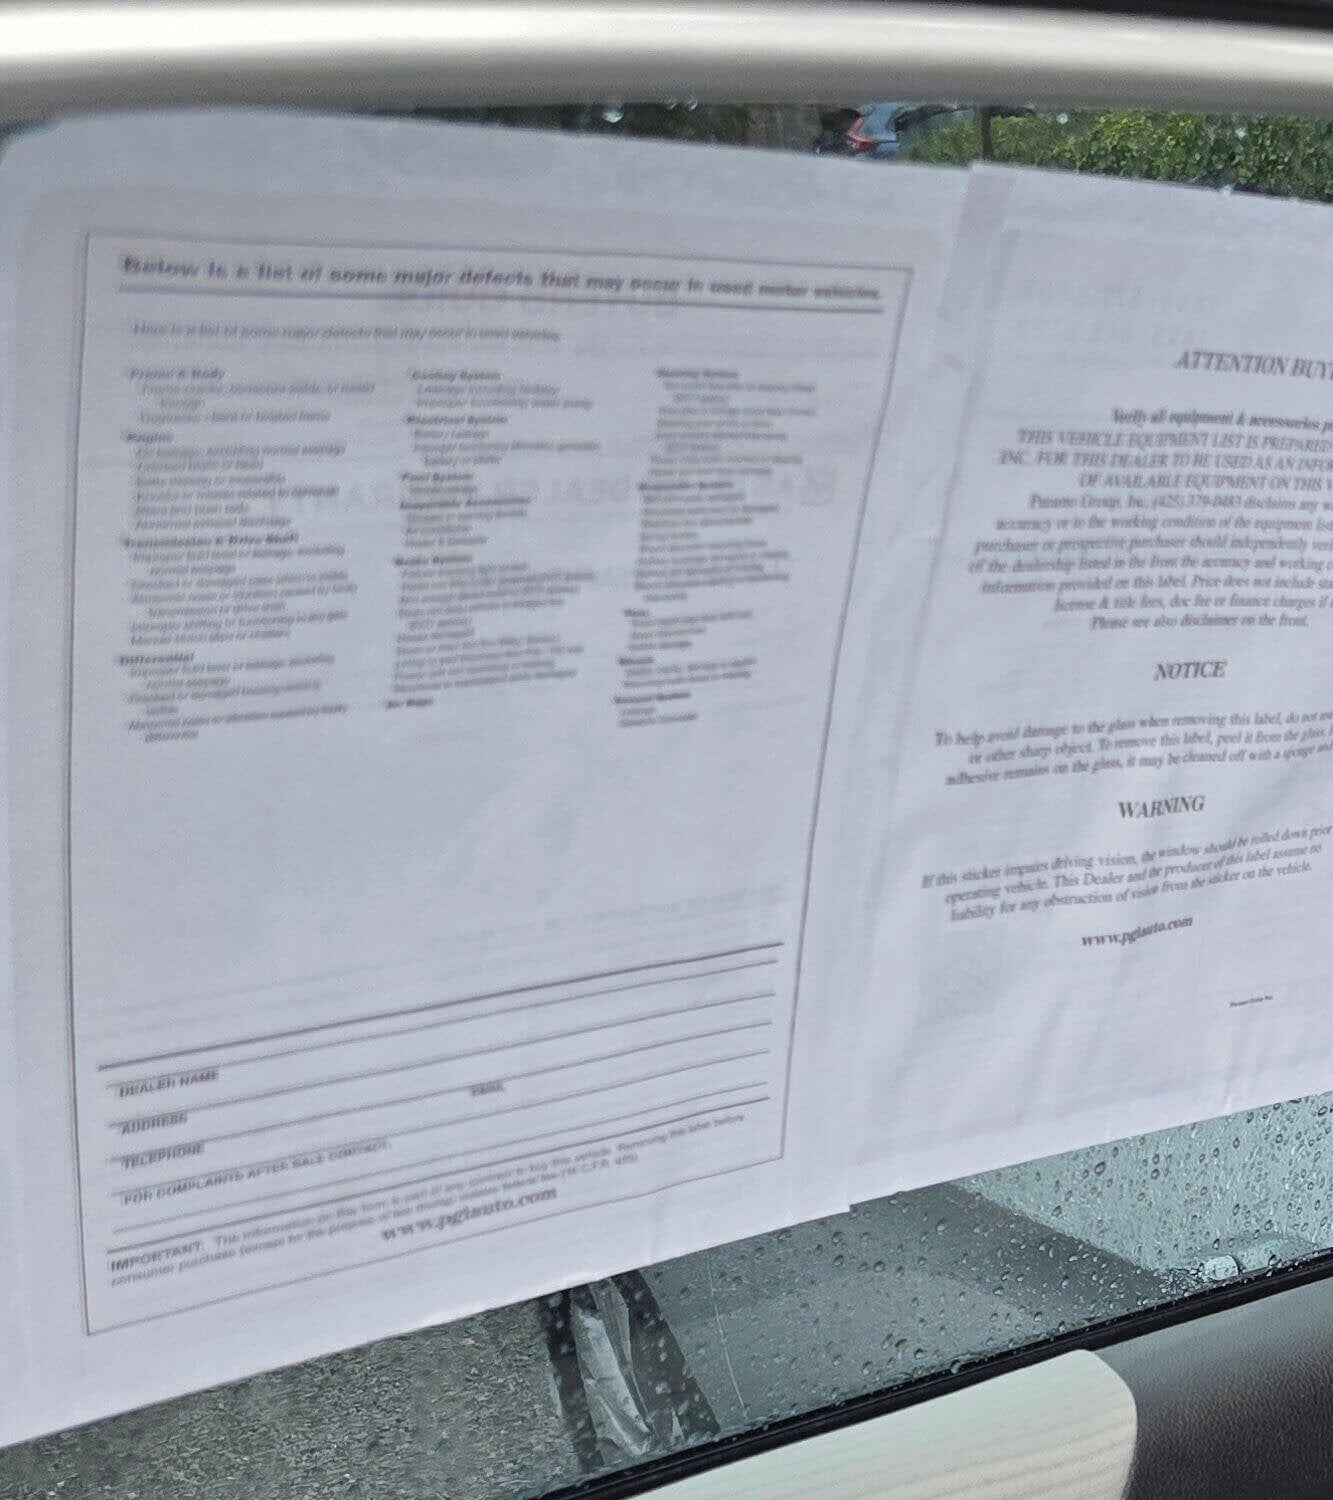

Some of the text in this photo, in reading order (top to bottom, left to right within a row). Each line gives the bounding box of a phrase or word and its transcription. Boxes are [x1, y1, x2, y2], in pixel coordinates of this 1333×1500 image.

[1174, 349, 1287, 376] ATTENTION
[1152, 660, 1227, 682] NOTICE
[1118, 795, 1206, 820] WARNING
